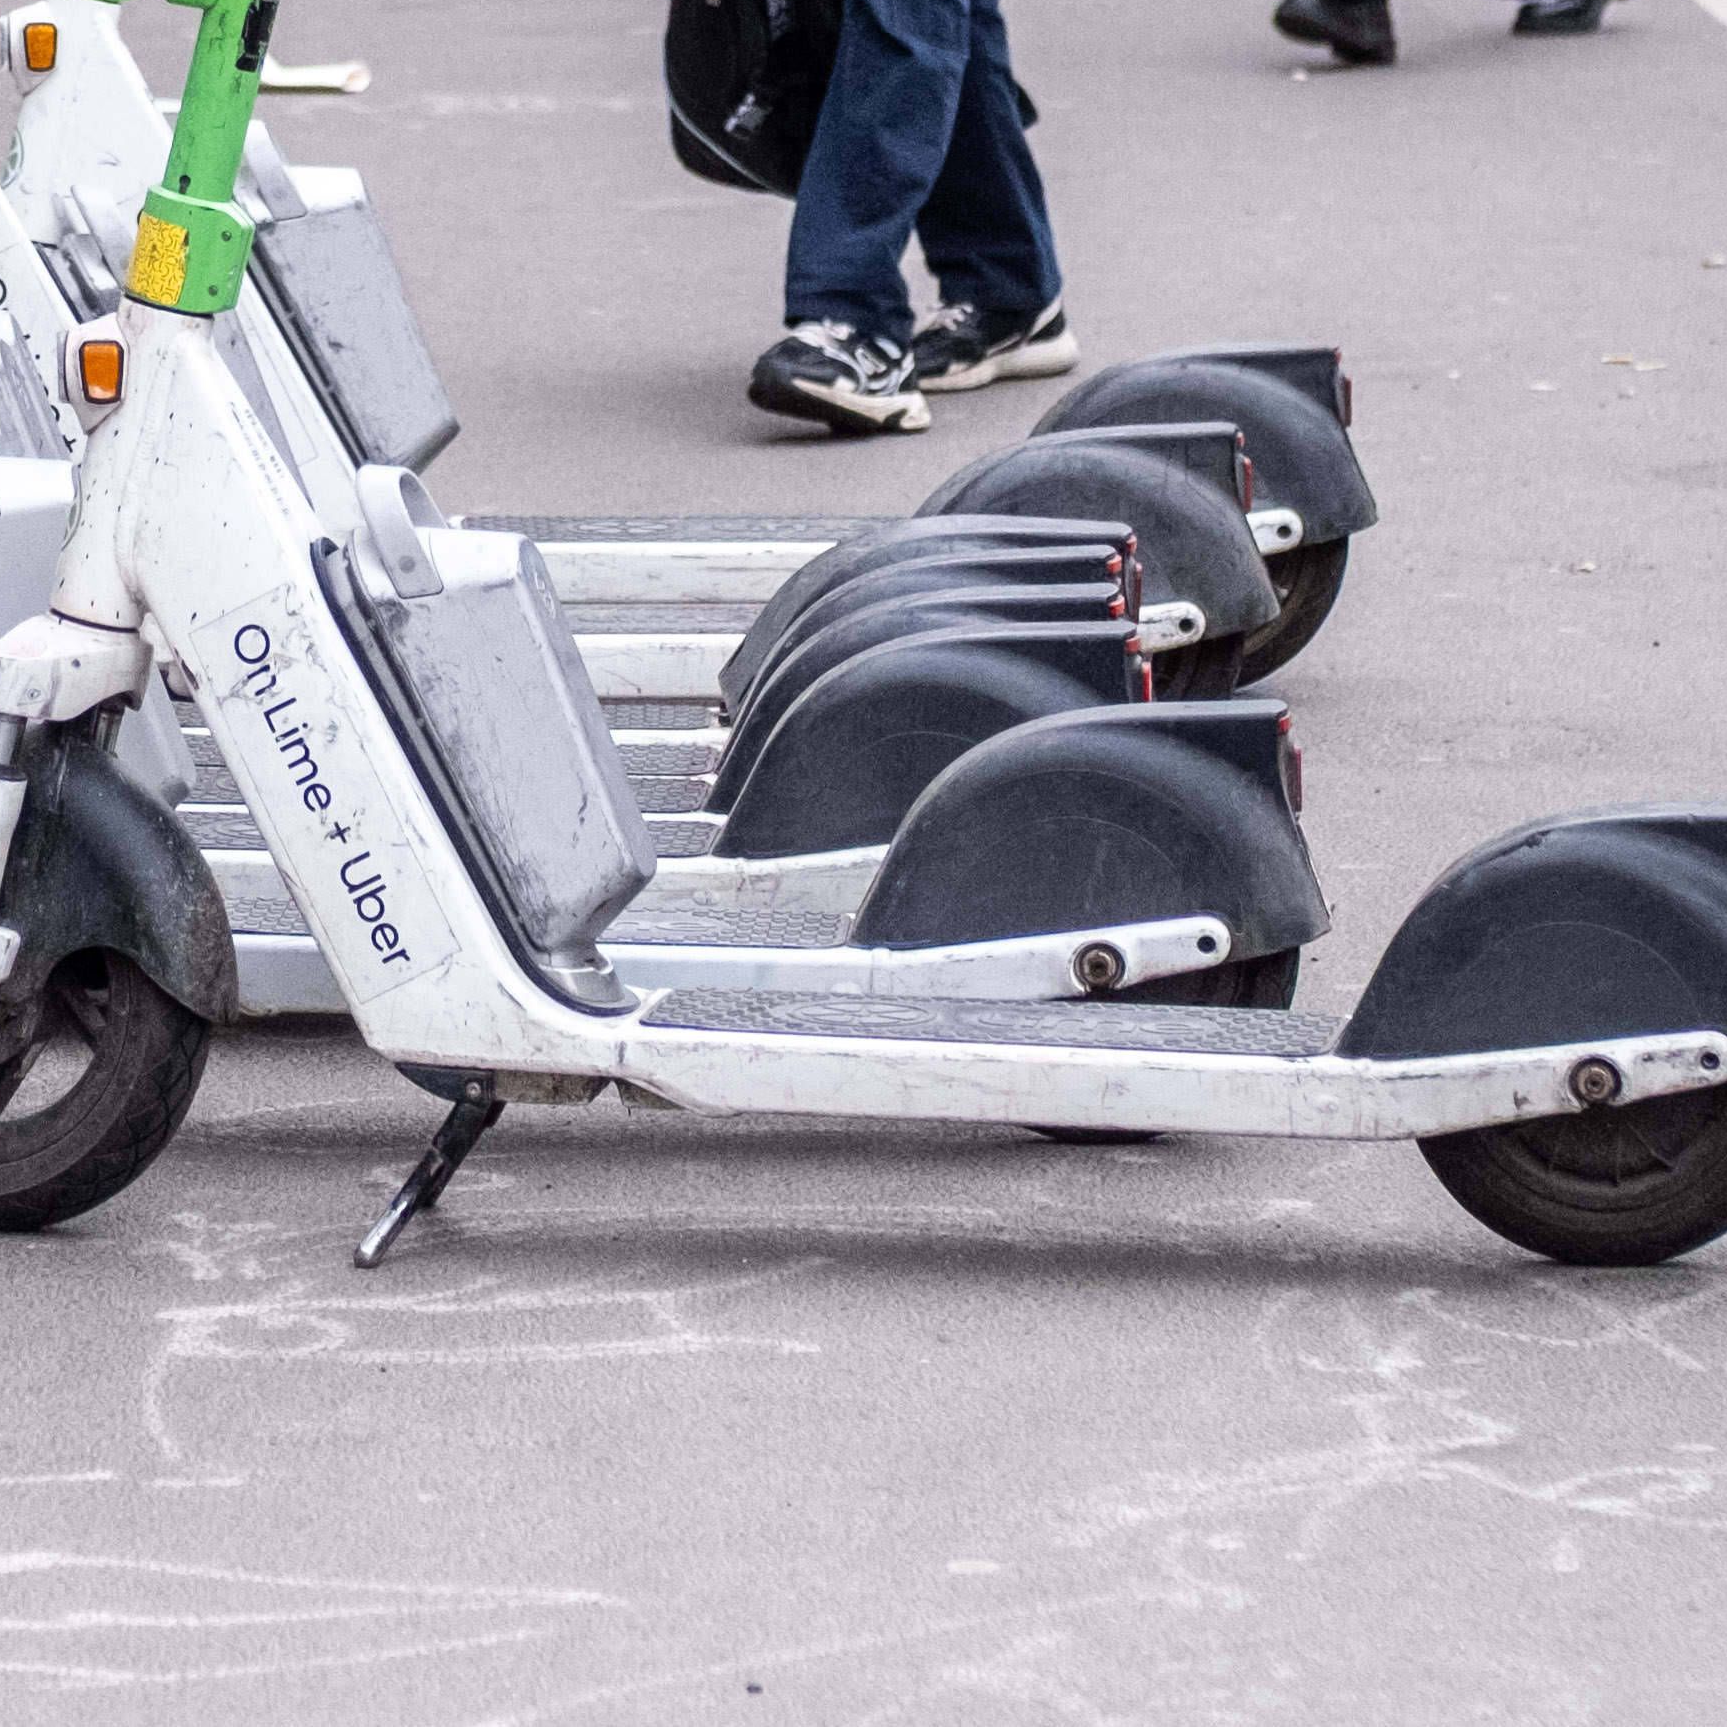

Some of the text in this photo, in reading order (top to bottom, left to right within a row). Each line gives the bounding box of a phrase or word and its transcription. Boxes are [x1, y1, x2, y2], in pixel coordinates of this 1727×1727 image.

[234, 624, 411, 964] On Lime + Uber
